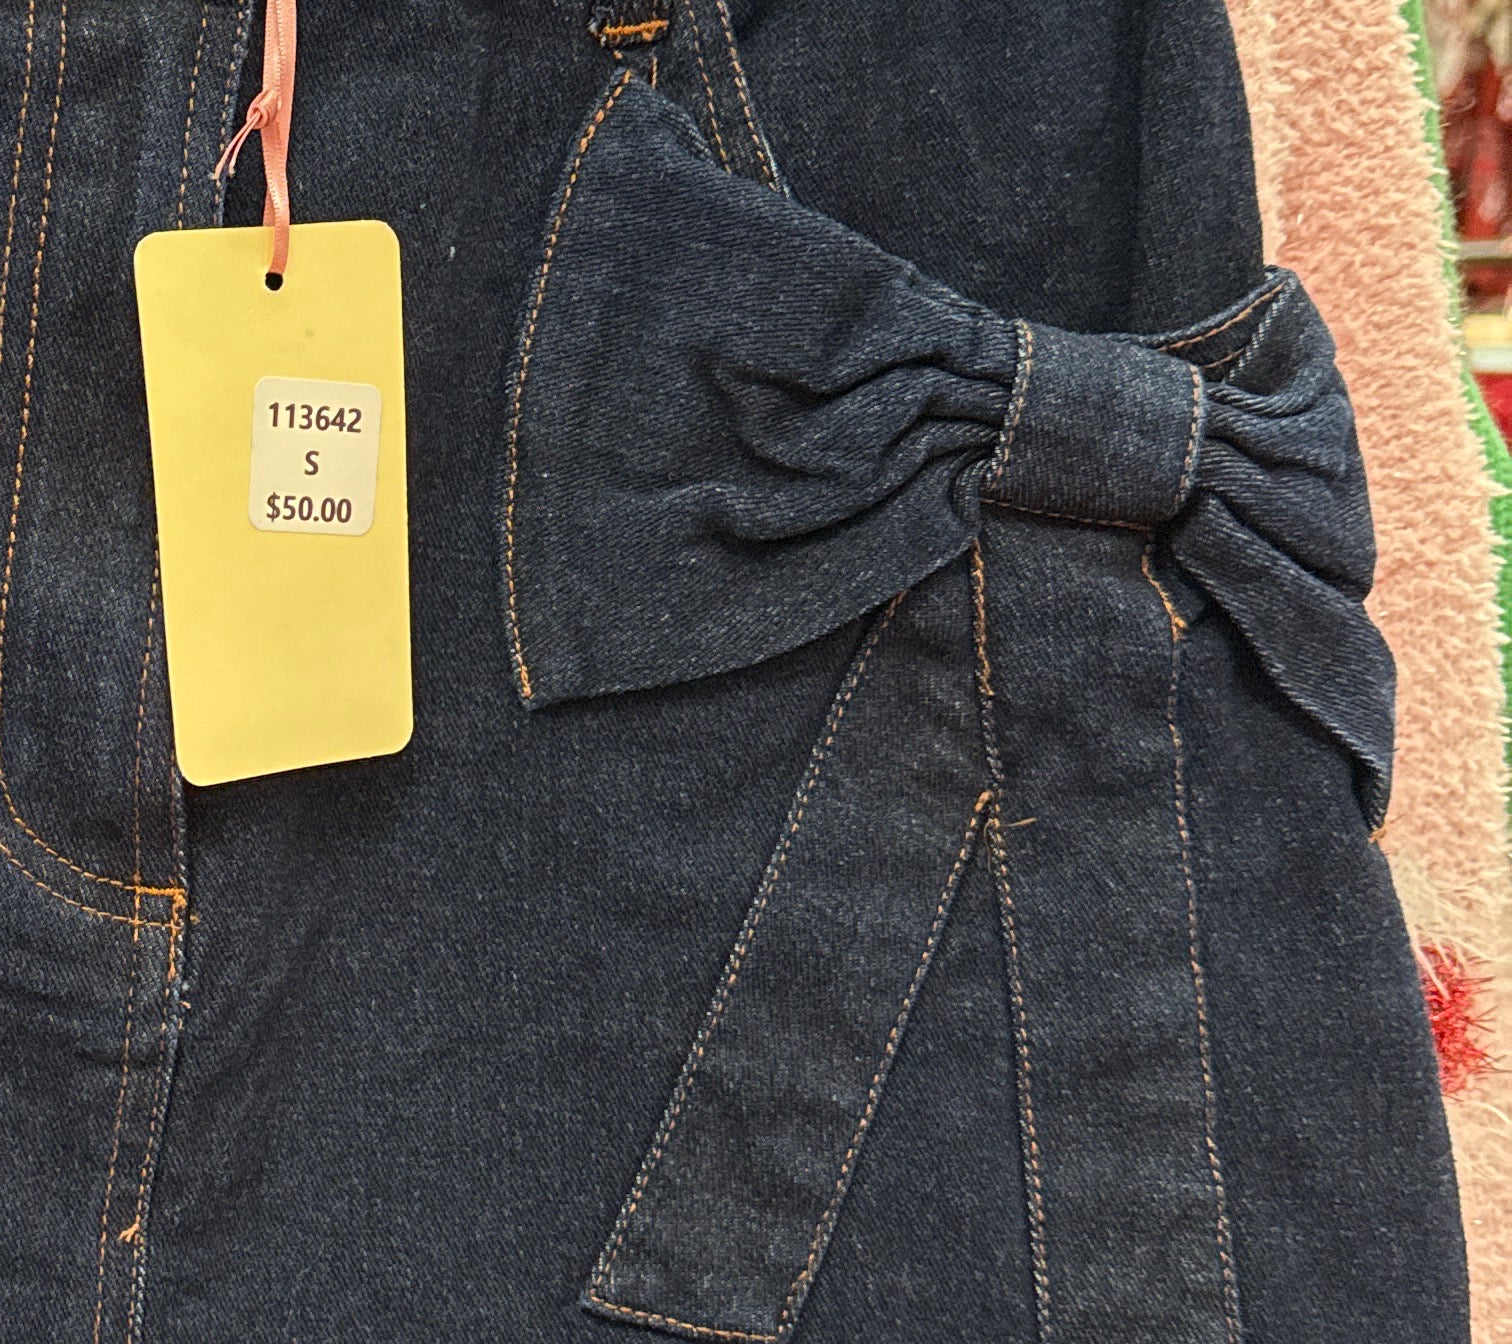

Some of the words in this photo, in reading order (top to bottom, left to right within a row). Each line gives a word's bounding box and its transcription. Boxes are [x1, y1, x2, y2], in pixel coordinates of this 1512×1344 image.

[268, 401, 363, 433] 113642
[304, 450, 320, 476] S
[266, 491, 353, 524] $50.00
